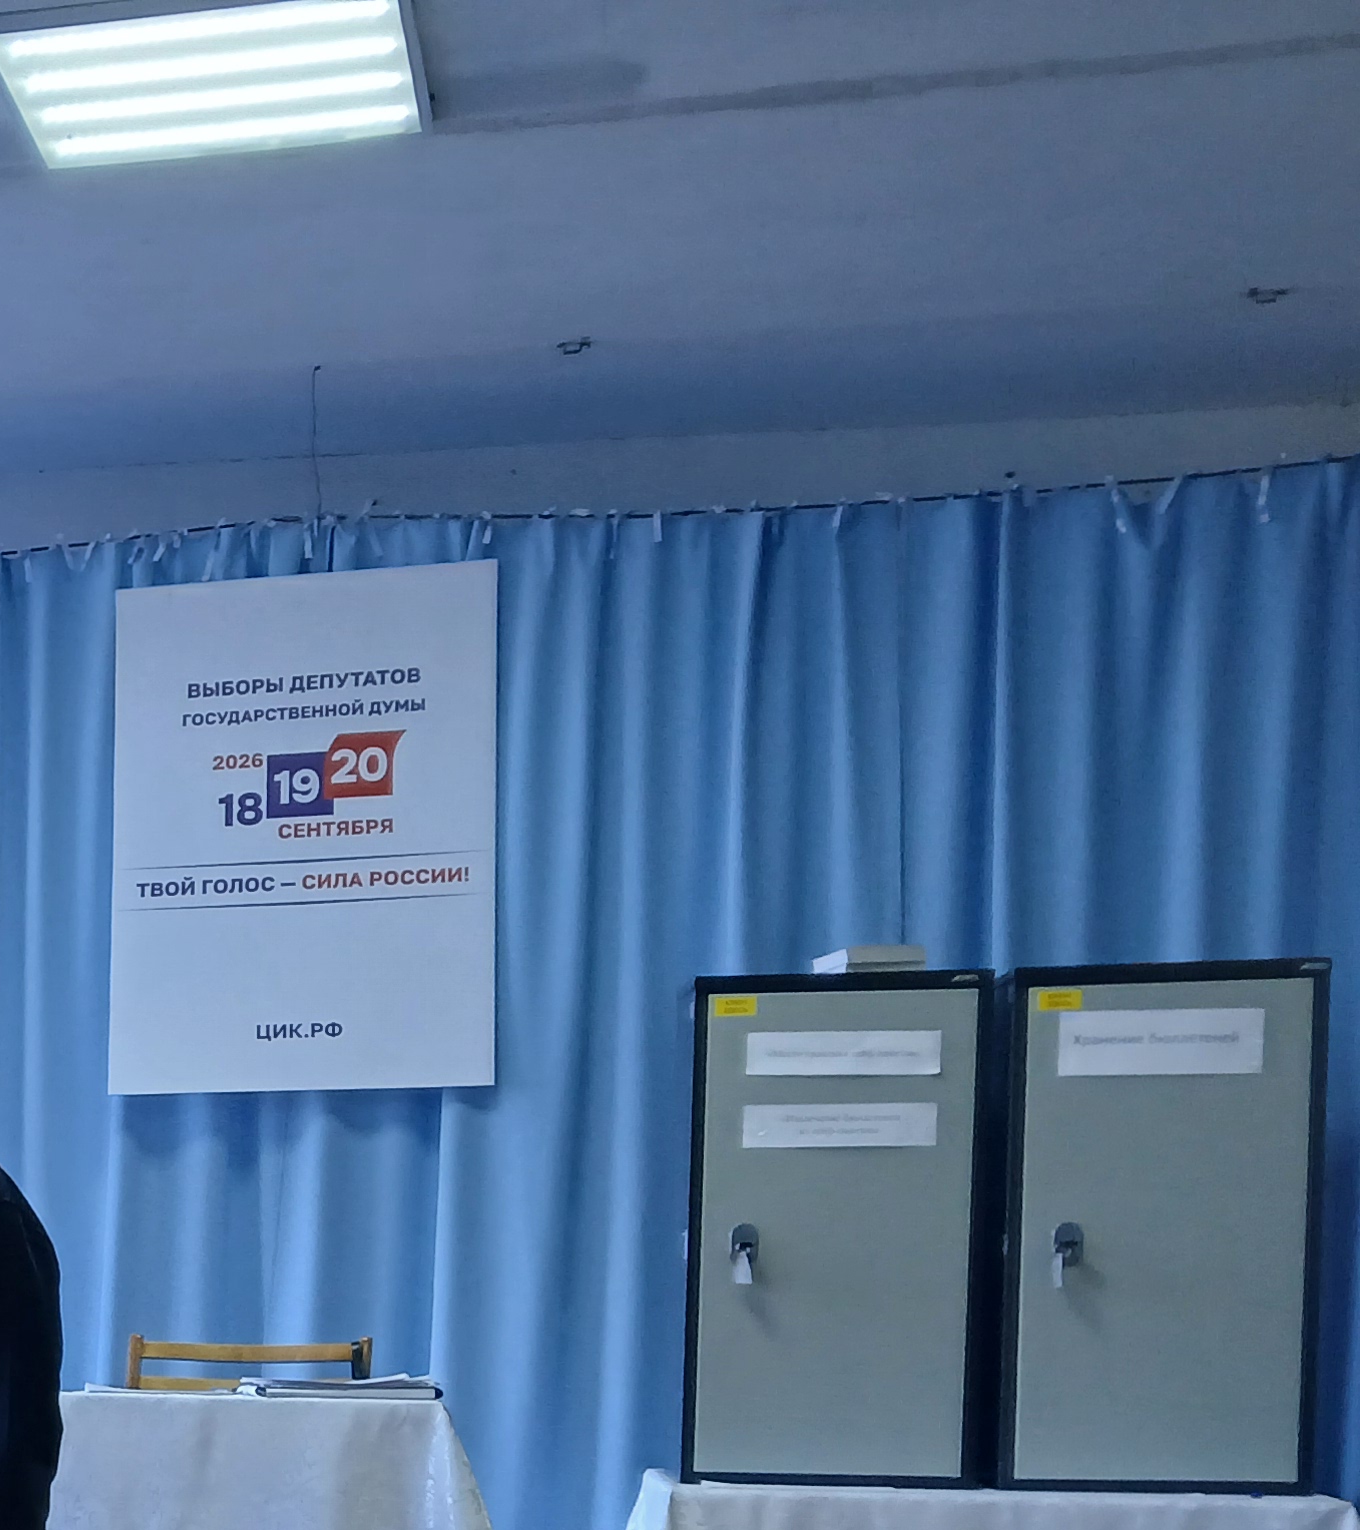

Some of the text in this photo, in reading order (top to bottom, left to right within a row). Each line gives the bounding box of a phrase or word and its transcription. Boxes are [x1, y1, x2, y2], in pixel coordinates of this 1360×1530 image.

[187, 667, 422, 699] ВЫБОРЫ ДЕПУТАТОВ
[182, 697, 427, 727] ГОСУДАРСТВЕННОЙ ДУМЫ
[212, 752, 264, 771] 2026
[218, 746, 388, 828] 18 19 20
[277, 817, 395, 840] СЕНТЯБРЯ
[136, 876, 196, 898] ТВОЙ
[202, 876, 276, 896] ГОЛОС
[301, 873, 364, 890] СИЛА
[368, 866, 471, 888] РОССИИ!
[256, 1021, 344, 1042] ЦИК.РФ
